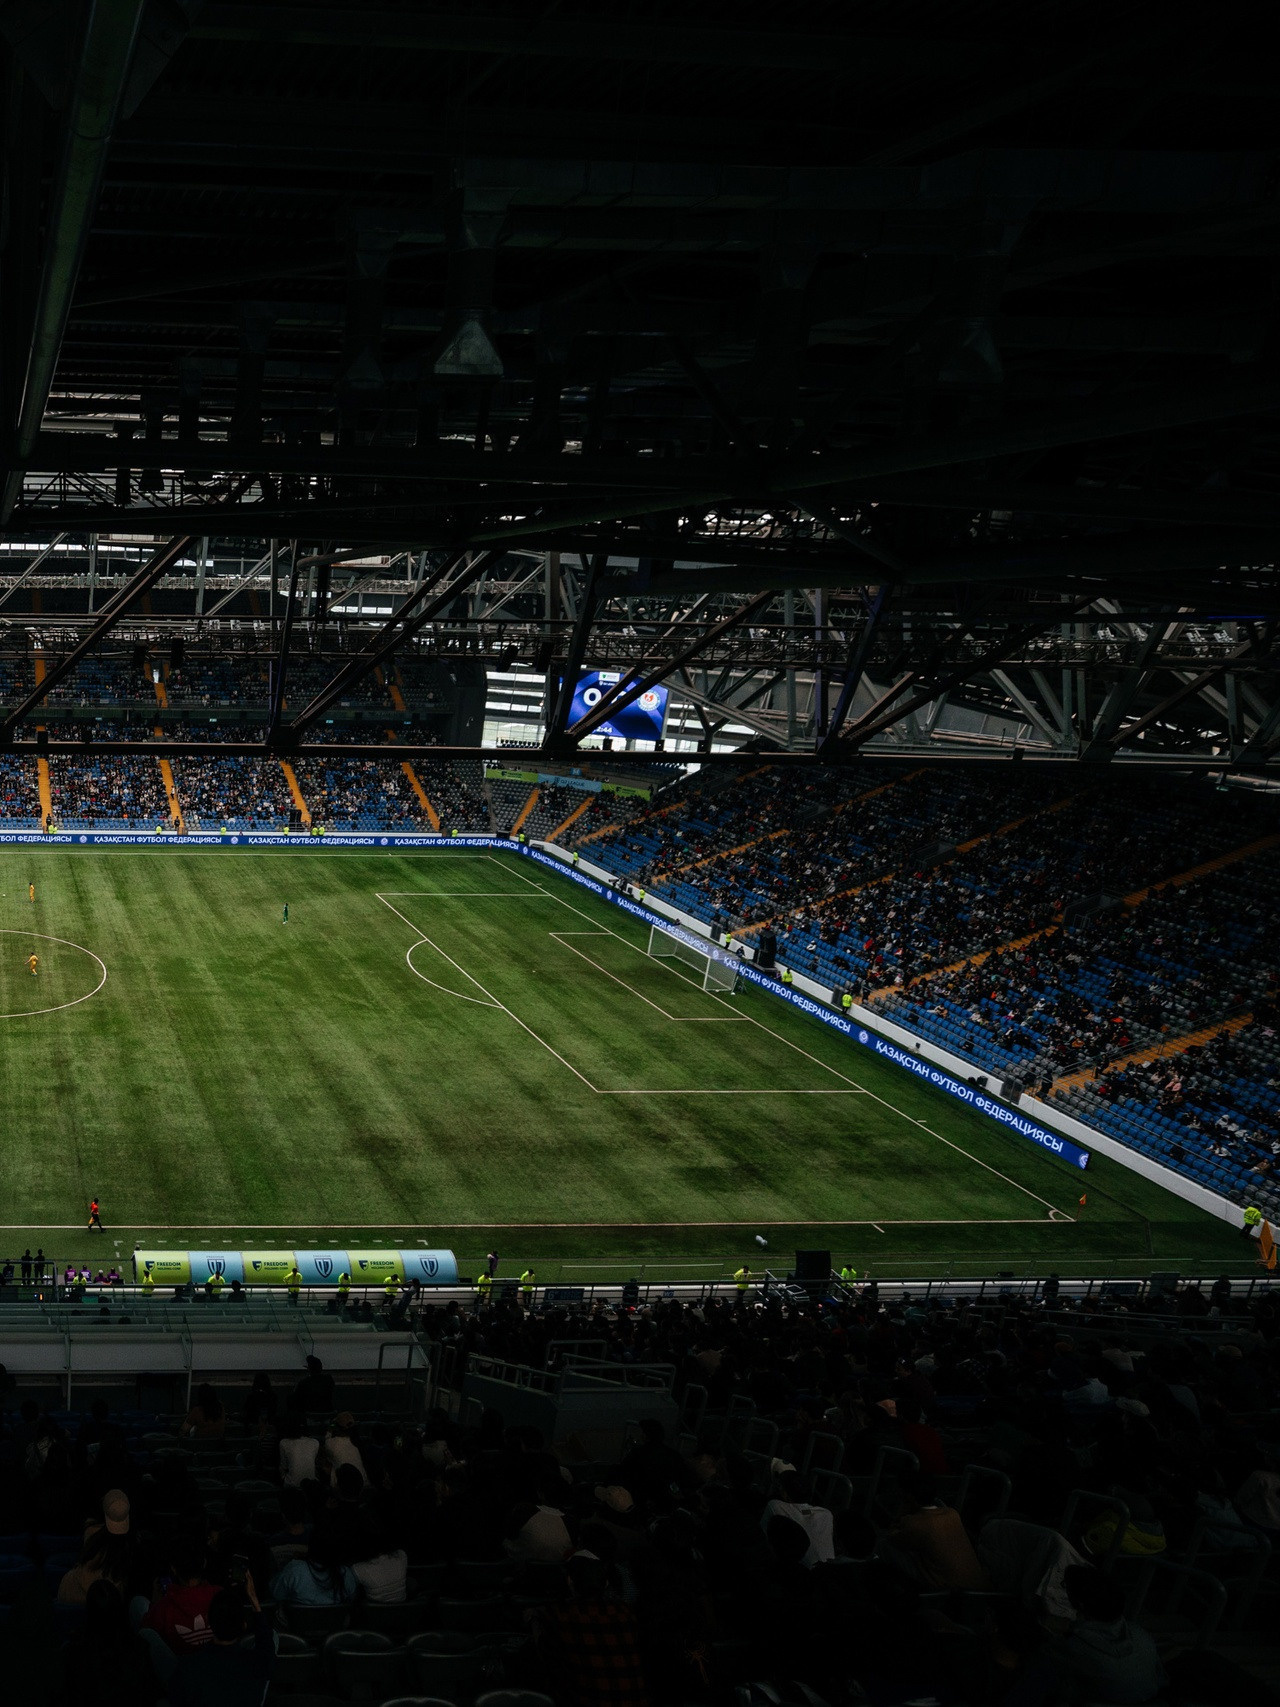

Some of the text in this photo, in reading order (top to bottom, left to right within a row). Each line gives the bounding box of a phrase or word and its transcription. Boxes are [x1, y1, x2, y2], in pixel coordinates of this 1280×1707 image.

[17, 835, 72, 843] ФЕДЕРАЦИЯСЫ
[136, 835, 166, 843] ФУТБОЛ
[167, 835, 222, 844] ФЕДЕРАЦИЯСЫ
[290, 836, 320, 844] ФУТБОЛ
[321, 836, 375, 845] ФЕДЕРАЦИЯСЫ
[436, 837, 465, 845] ФУТБОЛ
[761, 977, 792, 1000] ФУТБОЛ
[792, 994, 851, 1033] ФЕДЕРАЦИЯСЫ
[875, 1040, 1064, 1153] ҚАЗАҚСТАН ФУТБОЛ ФЕДЕРАЦИЯСЫ
